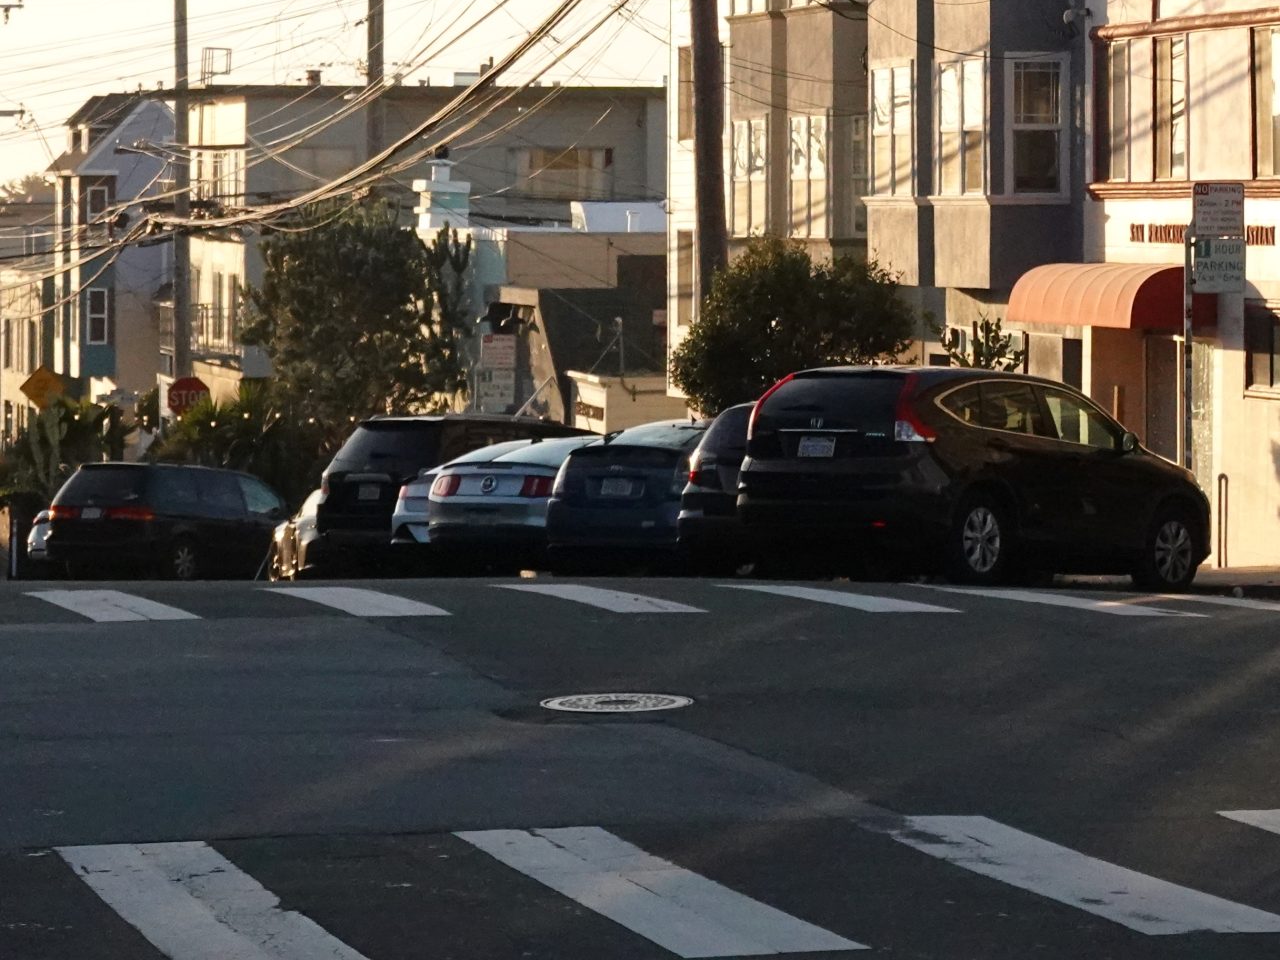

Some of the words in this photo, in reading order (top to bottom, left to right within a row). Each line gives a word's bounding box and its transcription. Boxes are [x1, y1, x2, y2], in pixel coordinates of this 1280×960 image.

[1196, 184, 1208, 194] NO
[1210, 186, 1241, 194] PARKING
[1130, 223, 1144, 242] SAN
[1214, 243, 1241, 255] HOUR
[1196, 260, 1243, 272] PARKING
[170, 390, 207, 407] STOP
